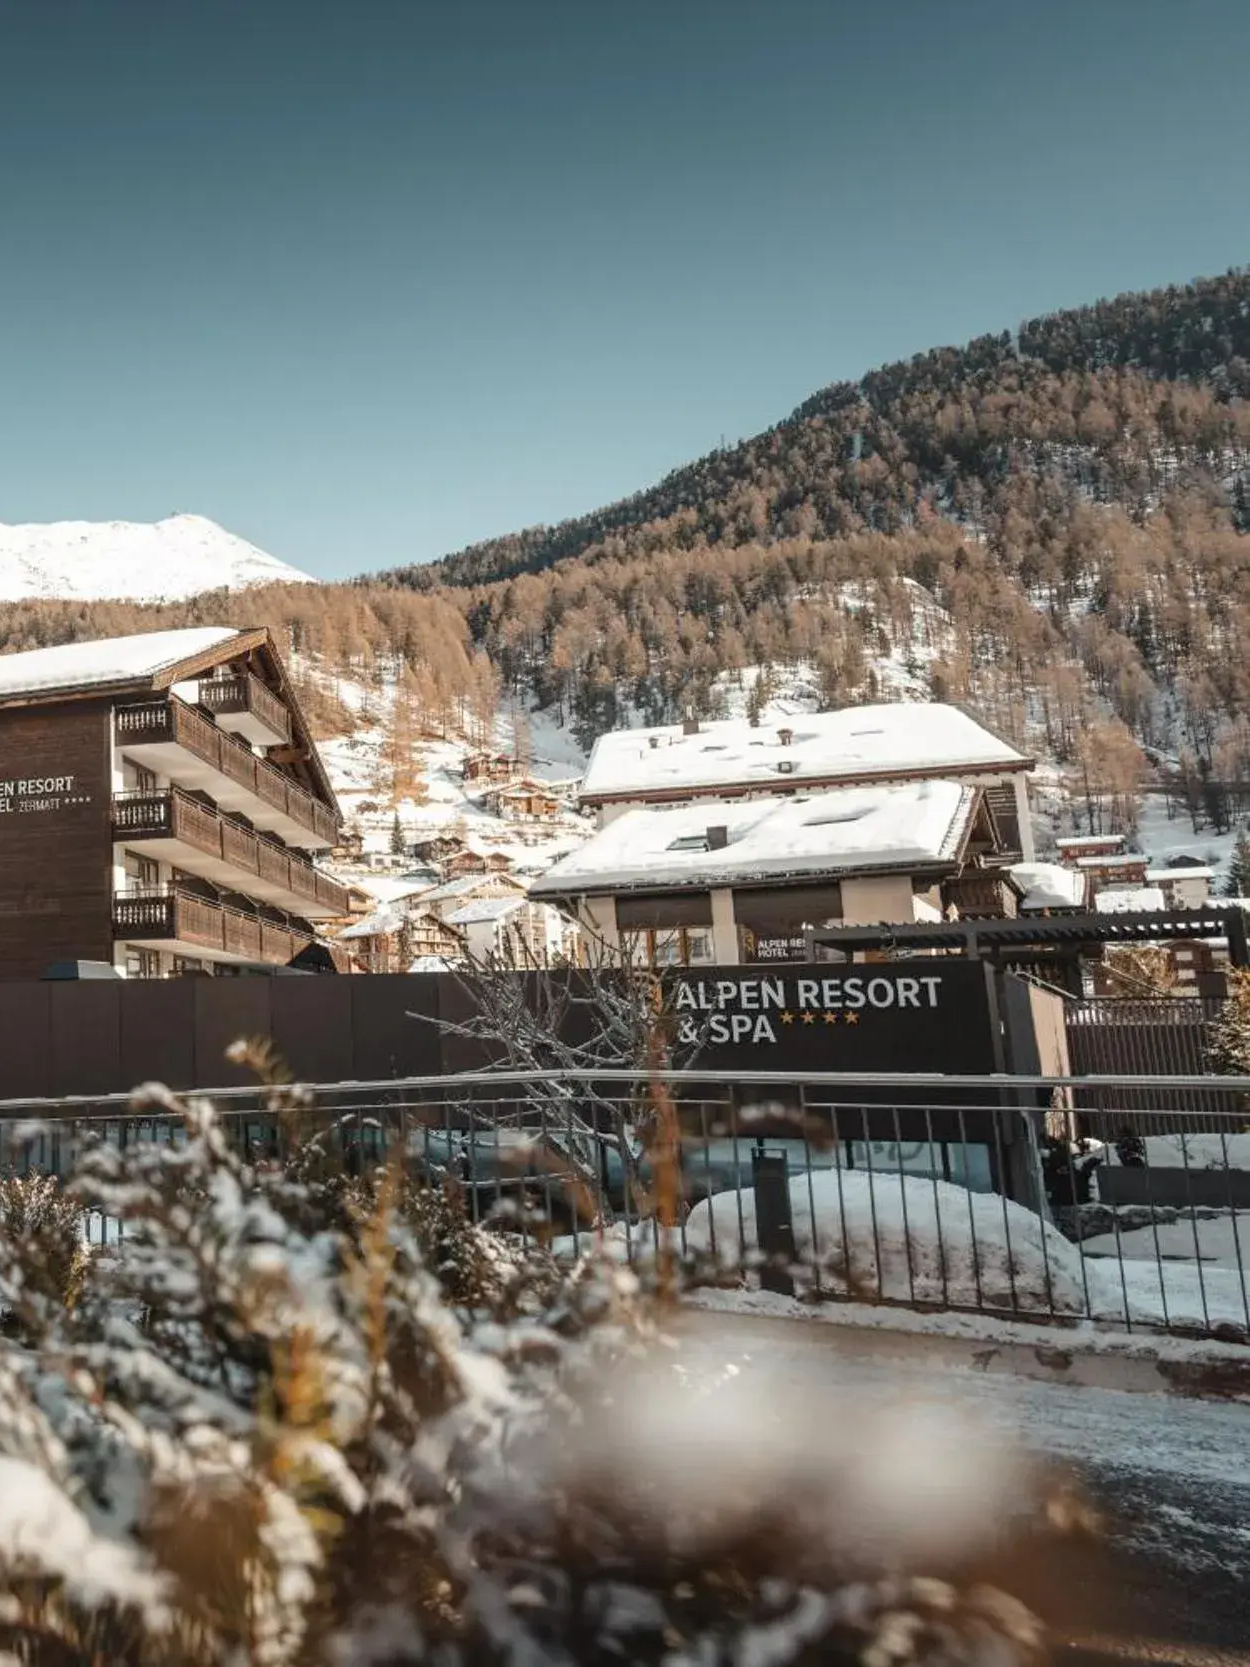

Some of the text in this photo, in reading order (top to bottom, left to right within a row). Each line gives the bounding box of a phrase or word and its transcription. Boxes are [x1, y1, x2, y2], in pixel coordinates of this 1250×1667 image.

[18, 776, 74, 796] RESORT
[19, 798, 60, 812] ZERMATT
[758, 939, 788, 949] ALPEN
[758, 948, 789, 958] HOTEL
[676, 977, 942, 1010] ALPEN RESORT
[678, 1014, 777, 1043] & SPA
